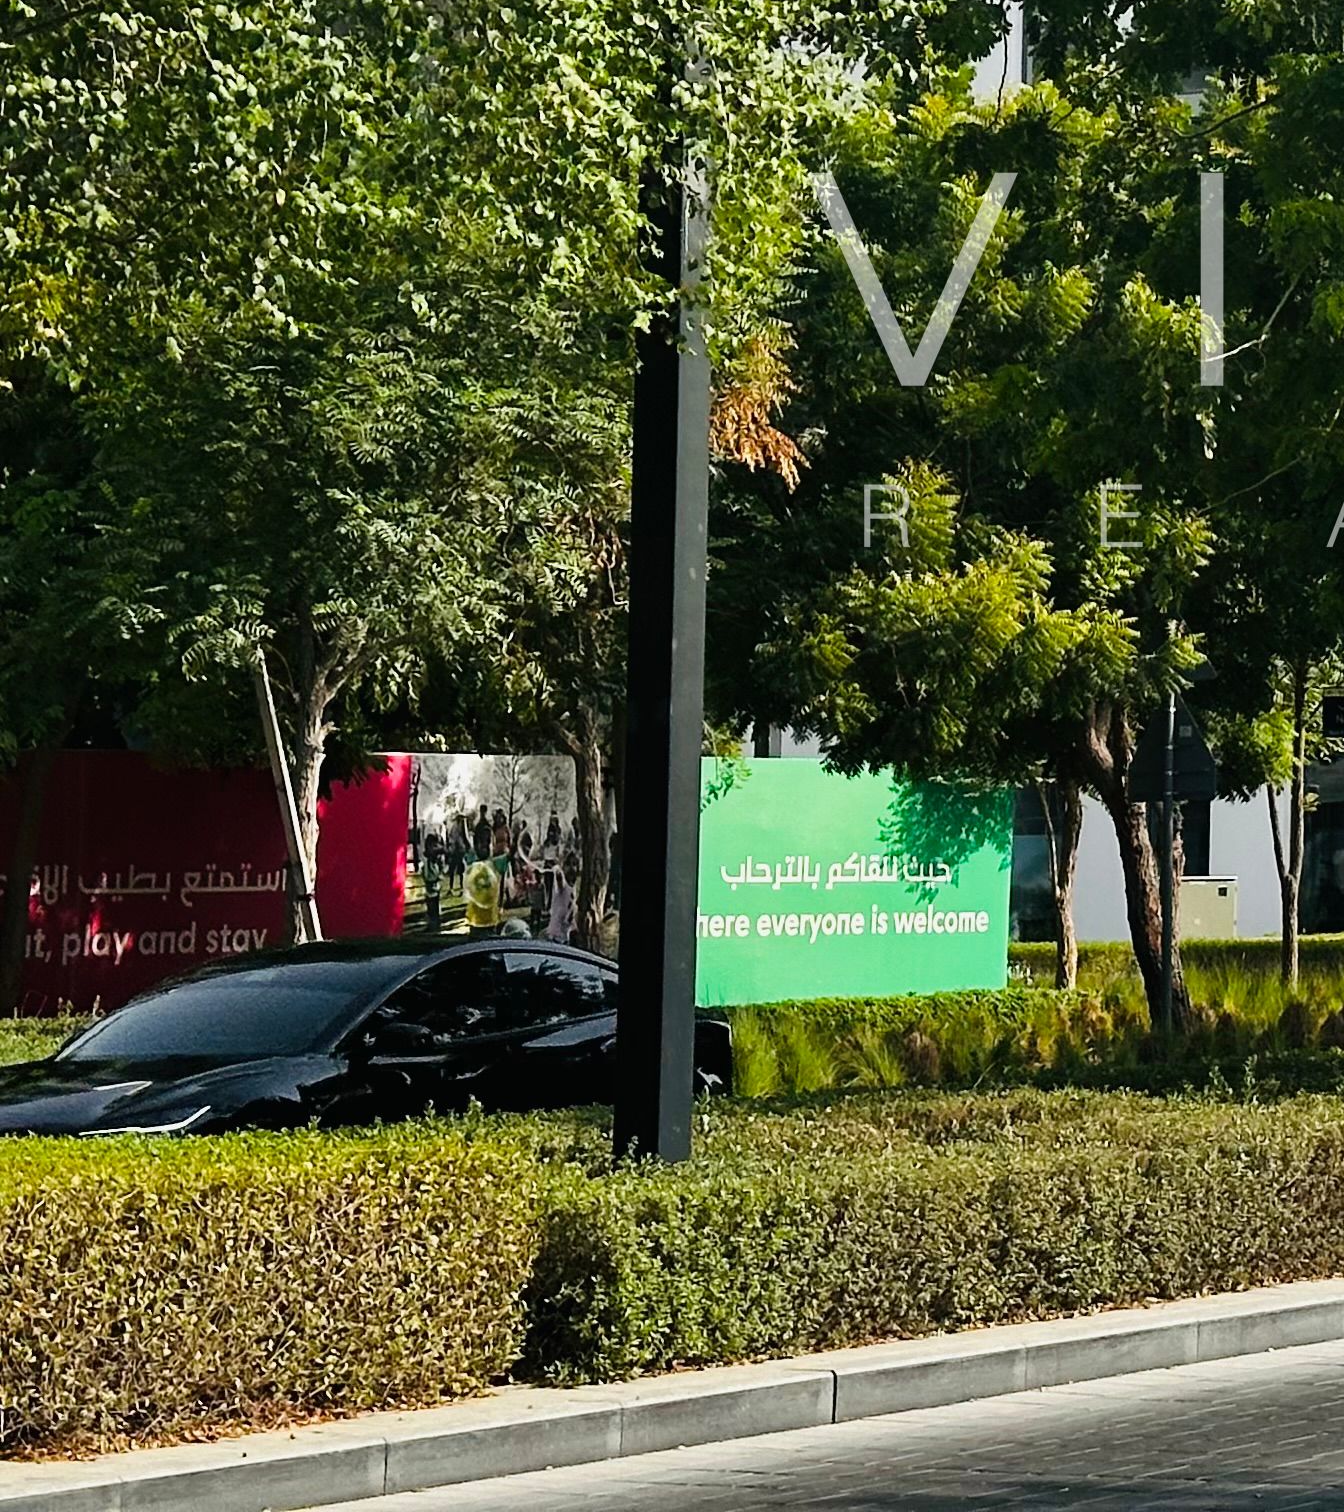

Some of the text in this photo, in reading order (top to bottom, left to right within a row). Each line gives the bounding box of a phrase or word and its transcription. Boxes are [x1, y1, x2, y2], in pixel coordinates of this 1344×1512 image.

[180, 862, 288, 908] استمتع
[720, 855, 821, 890] بالترحاب
[902, 856, 952, 890] حيث
[61, 922, 132, 967] play
[138, 920, 197, 956] and
[204, 923, 268, 956] stay
[696, 904, 990, 944] here everyone is welcome
